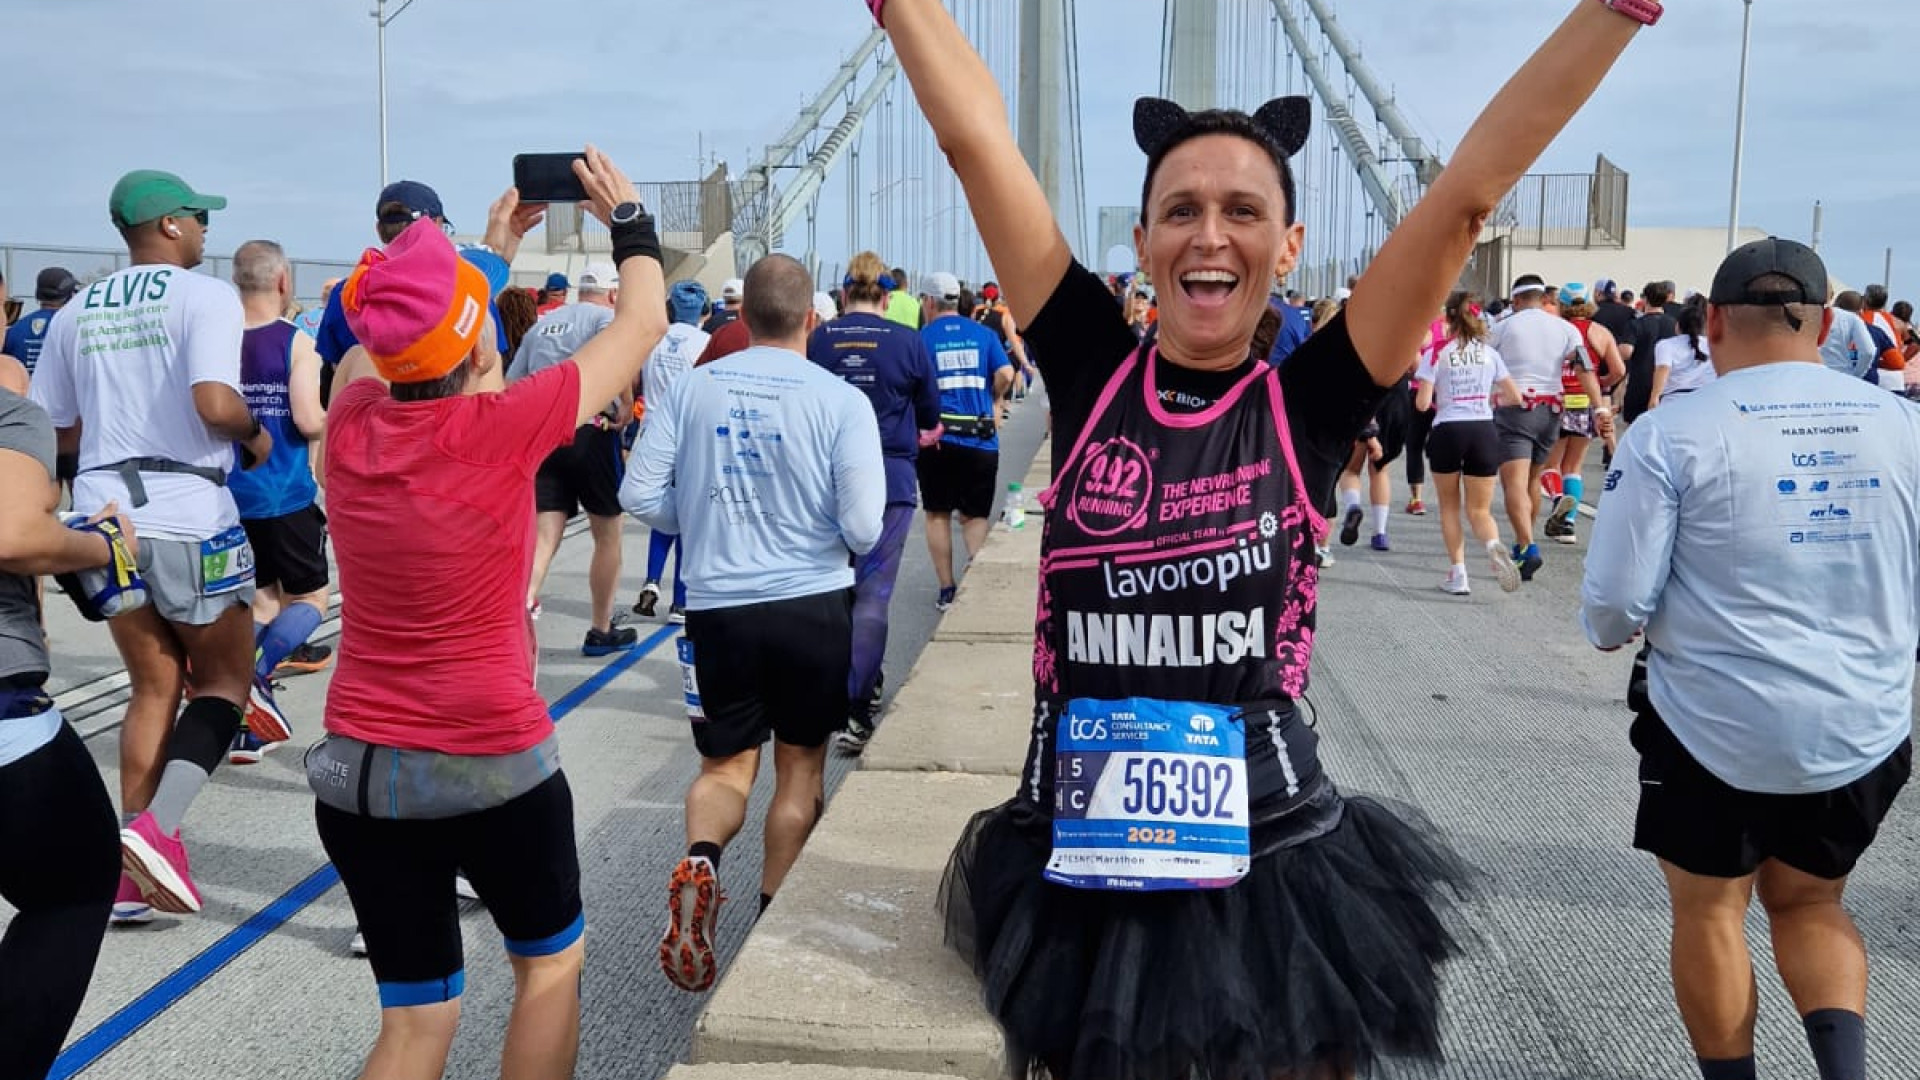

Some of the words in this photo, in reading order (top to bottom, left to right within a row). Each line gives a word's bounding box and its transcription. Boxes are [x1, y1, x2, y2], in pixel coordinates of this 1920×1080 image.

[84, 269, 172, 309] ELVIS
[1450, 350, 1485, 367] EVIE
[1781, 425, 1859, 436] MARATHONER
[1162, 481, 1189, 500] THE
[1078, 496, 1134, 518] RUNNING
[1159, 483, 1252, 522] EXPERIENCE
[1156, 532, 1191, 546] OFFICIAL
[1193, 527, 1218, 540] TEAM
[1067, 606, 1265, 667] ANNALISA
[1070, 714, 1108, 741] tcs
[1111, 712, 1137, 721] TATA
[1111, 722, 1171, 731] CONSULTANCY
[1111, 731, 1149, 740] SERVICES
[1185, 733, 1219, 746] TATA
[1071, 757, 1083, 777] 5
[1122, 757, 1234, 819] 56392
[1071, 789, 1085, 809] C
[1127, 826, 1177, 845] 2022
